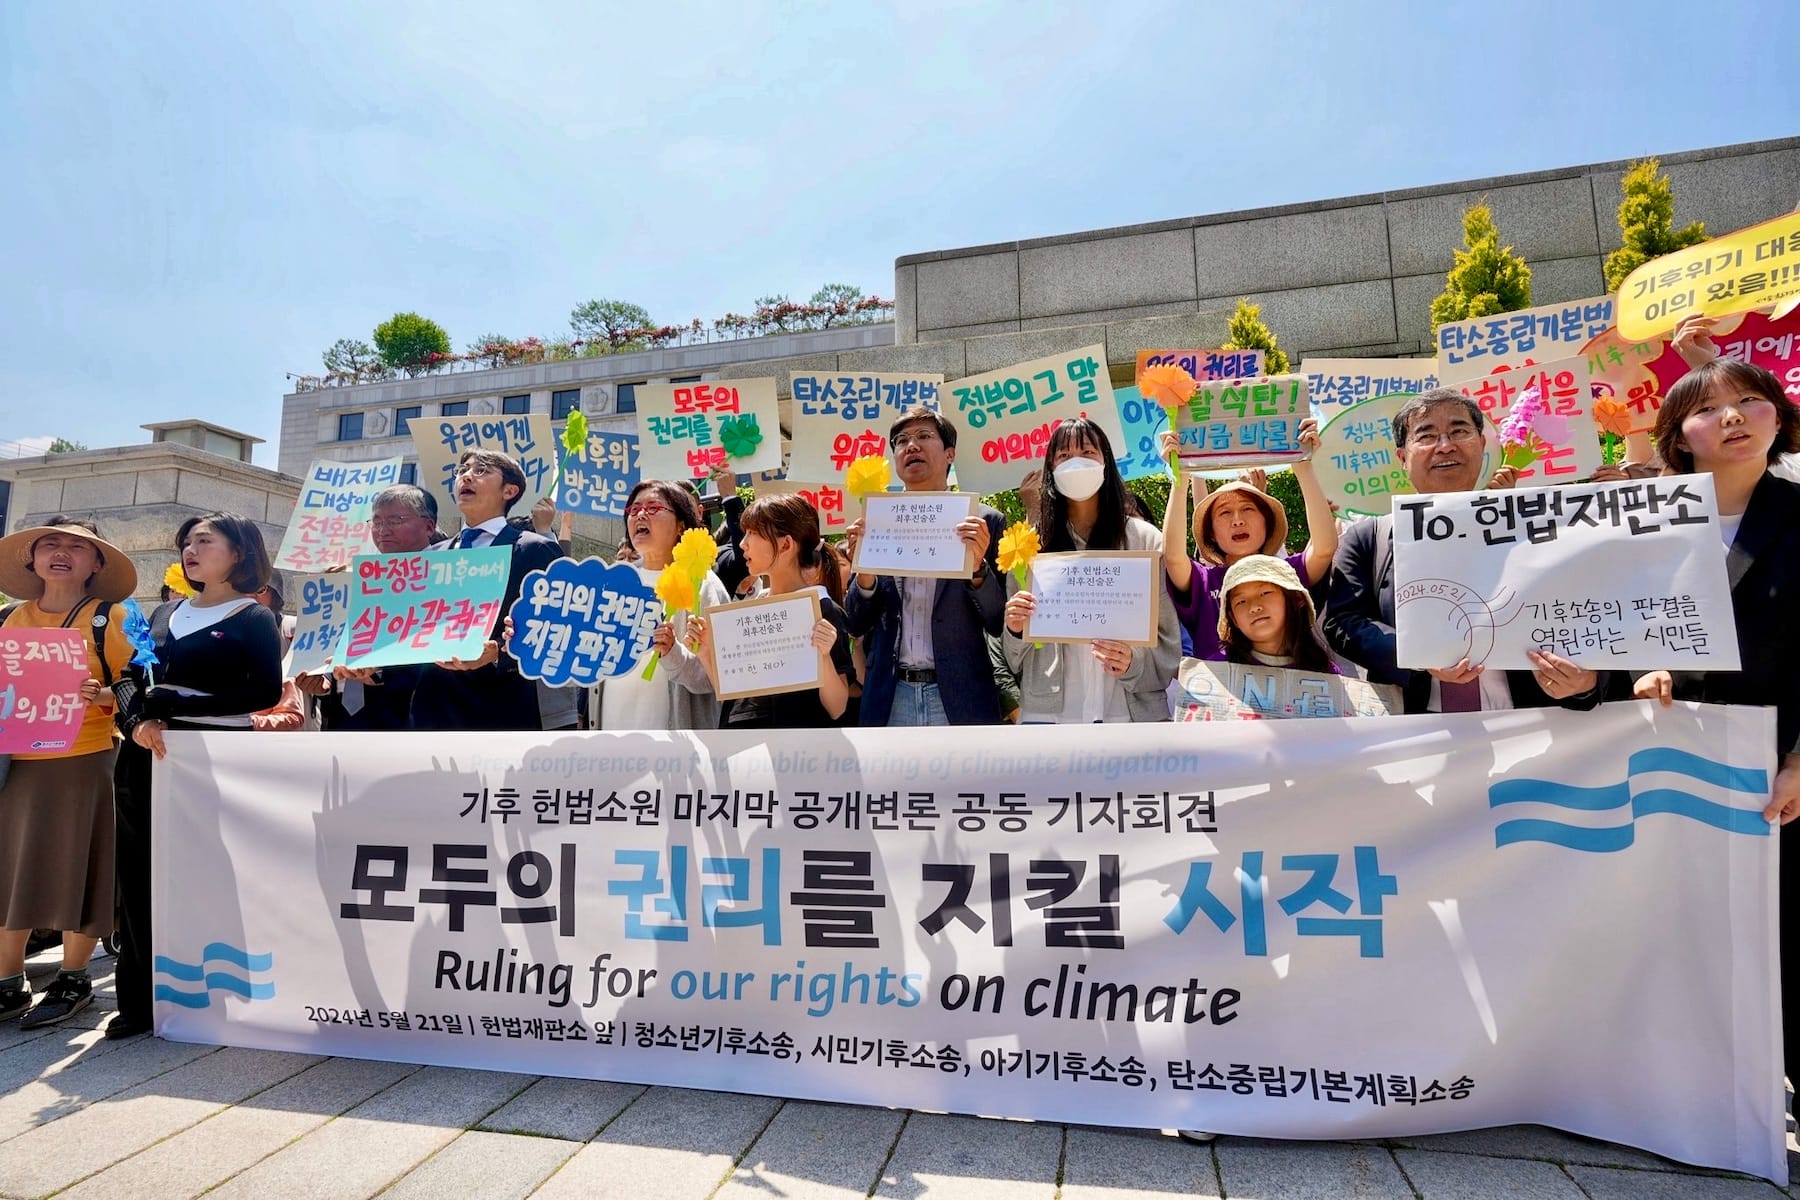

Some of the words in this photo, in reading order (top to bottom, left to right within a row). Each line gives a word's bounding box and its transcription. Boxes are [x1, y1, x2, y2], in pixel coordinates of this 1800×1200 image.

[1633, 249, 1743, 300] 기후위기
[1644, 289, 1695, 321] 이의
[1441, 300, 1613, 364] 탄소중립기본법
[793, 377, 940, 420] 탄소중립기본법
[1067, 355, 1100, 404] 말
[674, 385, 740, 414] 모두의
[440, 416, 536, 454] 우리에겐
[647, 413, 713, 446] 권리를
[1179, 424, 1232, 450] 지금
[1239, 419, 1304, 451] 바로!
[314, 463, 397, 488] 배제의
[1330, 449, 1391, 474] 기후위기
[563, 468, 626, 516] 방관은
[298, 514, 370, 546] 전환의
[1400, 500, 1467, 542] To.
[1470, 483, 1710, 546] 헌법재판소
[358, 556, 429, 596] 안정된
[431, 557, 505, 586] 기후에서
[1061, 566, 1080, 576] 기후
[1083, 565, 1122, 577] 헌법소원
[302, 578, 349, 620] 오늘이
[735, 616, 753, 627] 기후
[754, 609, 788, 623] 헌법소원
[1524, 599, 1622, 624] 기후소송의
[1631, 595, 1700, 622] 판결을
[530, 578, 596, 623] 우리의
[594, 582, 667, 660] 권리를
[24, 638, 88, 670] 지키는
[522, 619, 573, 676] 지킬
[571, 630, 626, 680] 판결
[1530, 627, 1629, 657] 염원하는
[1644, 623, 1711, 655] 시민들
[40, 693, 84, 725] 요구
[529, 752, 649, 779] conference
[655, 754, 682, 773] on
[747, 750, 819, 779] public
[825, 750, 921, 780] hearing
[927, 751, 955, 780] of
[961, 749, 1061, 776] climate
[1068, 747, 1199, 781] litigation
[459, 787, 522, 824] 기후
[531, 788, 664, 826] 헌법소원
[674, 788, 780, 828] 마지막
[788, 790, 941, 832] 공개변론
[951, 791, 1033, 833] 공동
[1046, 790, 1219, 834] 기자회견
[340, 843, 577, 938] 모두의
[607, 844, 887, 949] 권리를
[917, 852, 1126, 951] 지킬
[1161, 845, 1400, 959] 시작
[434, 949, 576, 1009] Ruling
[587, 953, 658, 1010] for
[669, 969, 755, 1001] our
[769, 961, 923, 1018] rights
[939, 971, 1006, 1014] on
[1022, 964, 1242, 1026] climate
[304, 1005, 374, 1029] 2024년
[378, 1011, 412, 1031] 5월
[415, 1013, 464, 1035] 21일
[479, 1014, 588, 1042] 헌법재판소
[594, 1021, 616, 1046] 앞
[633, 1021, 802, 1063] 청소년기후소송,
[810, 1034, 971, 1077] 시민기후소송,
[980, 1047, 1158, 1093] 아기기후소송,
[1165, 1059, 1476, 1107] 탄소중립기본계획소송
